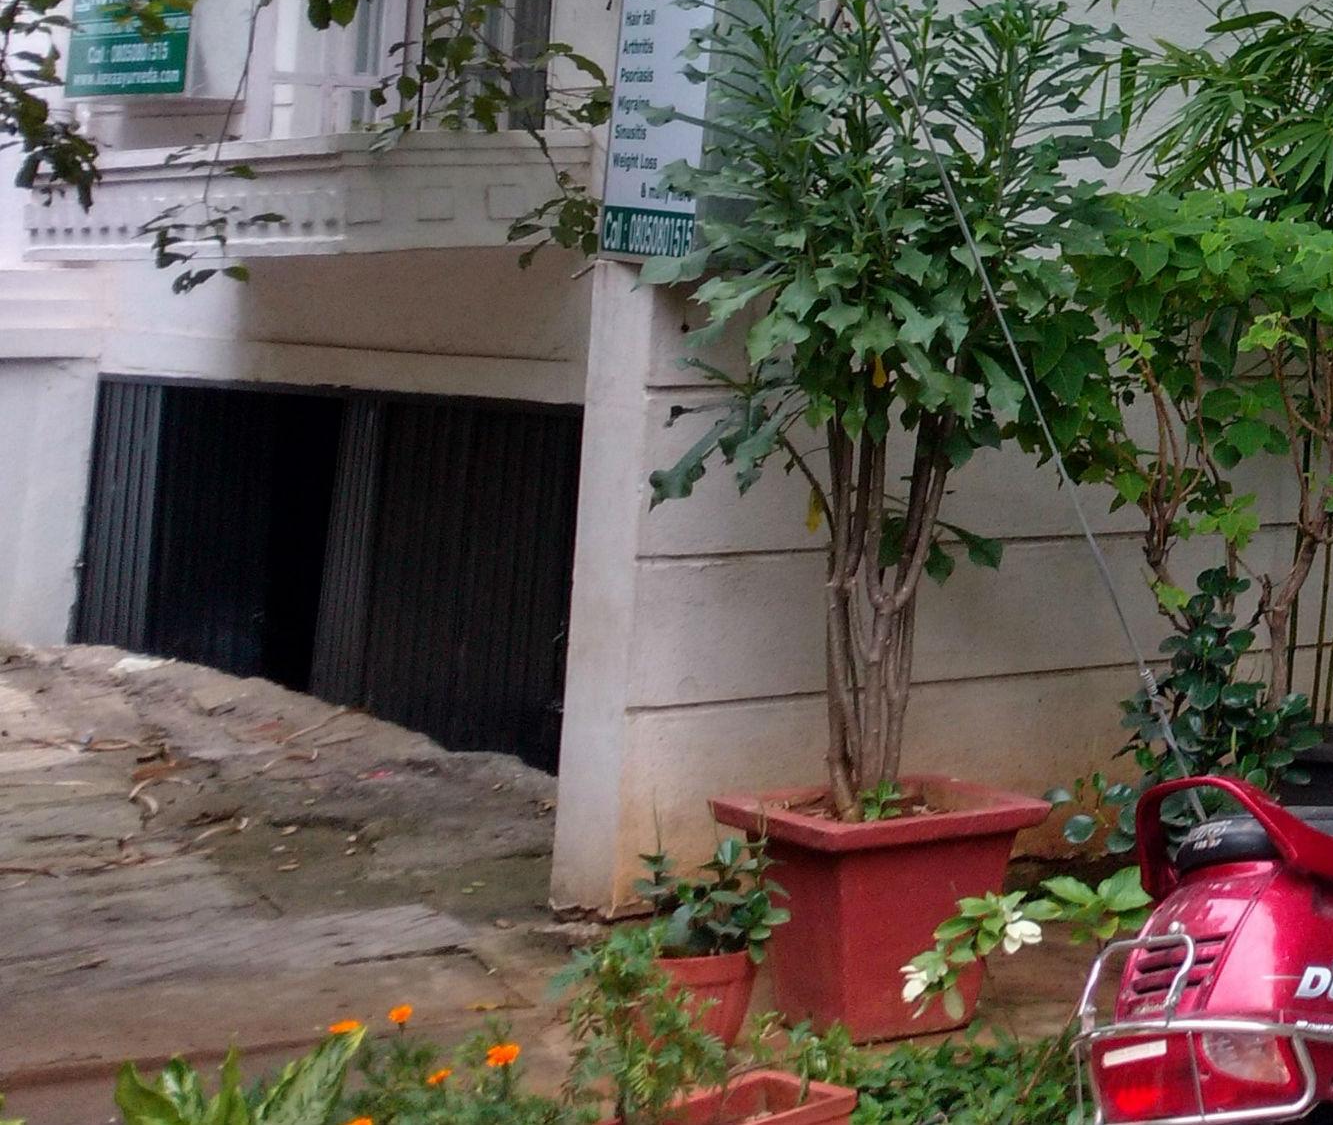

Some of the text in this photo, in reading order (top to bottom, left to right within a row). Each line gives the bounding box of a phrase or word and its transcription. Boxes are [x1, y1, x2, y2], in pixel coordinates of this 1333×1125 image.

[625, 10, 655, 26] Hair fall
[623, 38, 654, 54] Arthritis
[620, 66, 654, 83] Psoriasis
[614, 123, 647, 140] Sinusitis
[613, 152, 658, 172] Weight Loss
[603, 210, 623, 250] Call
